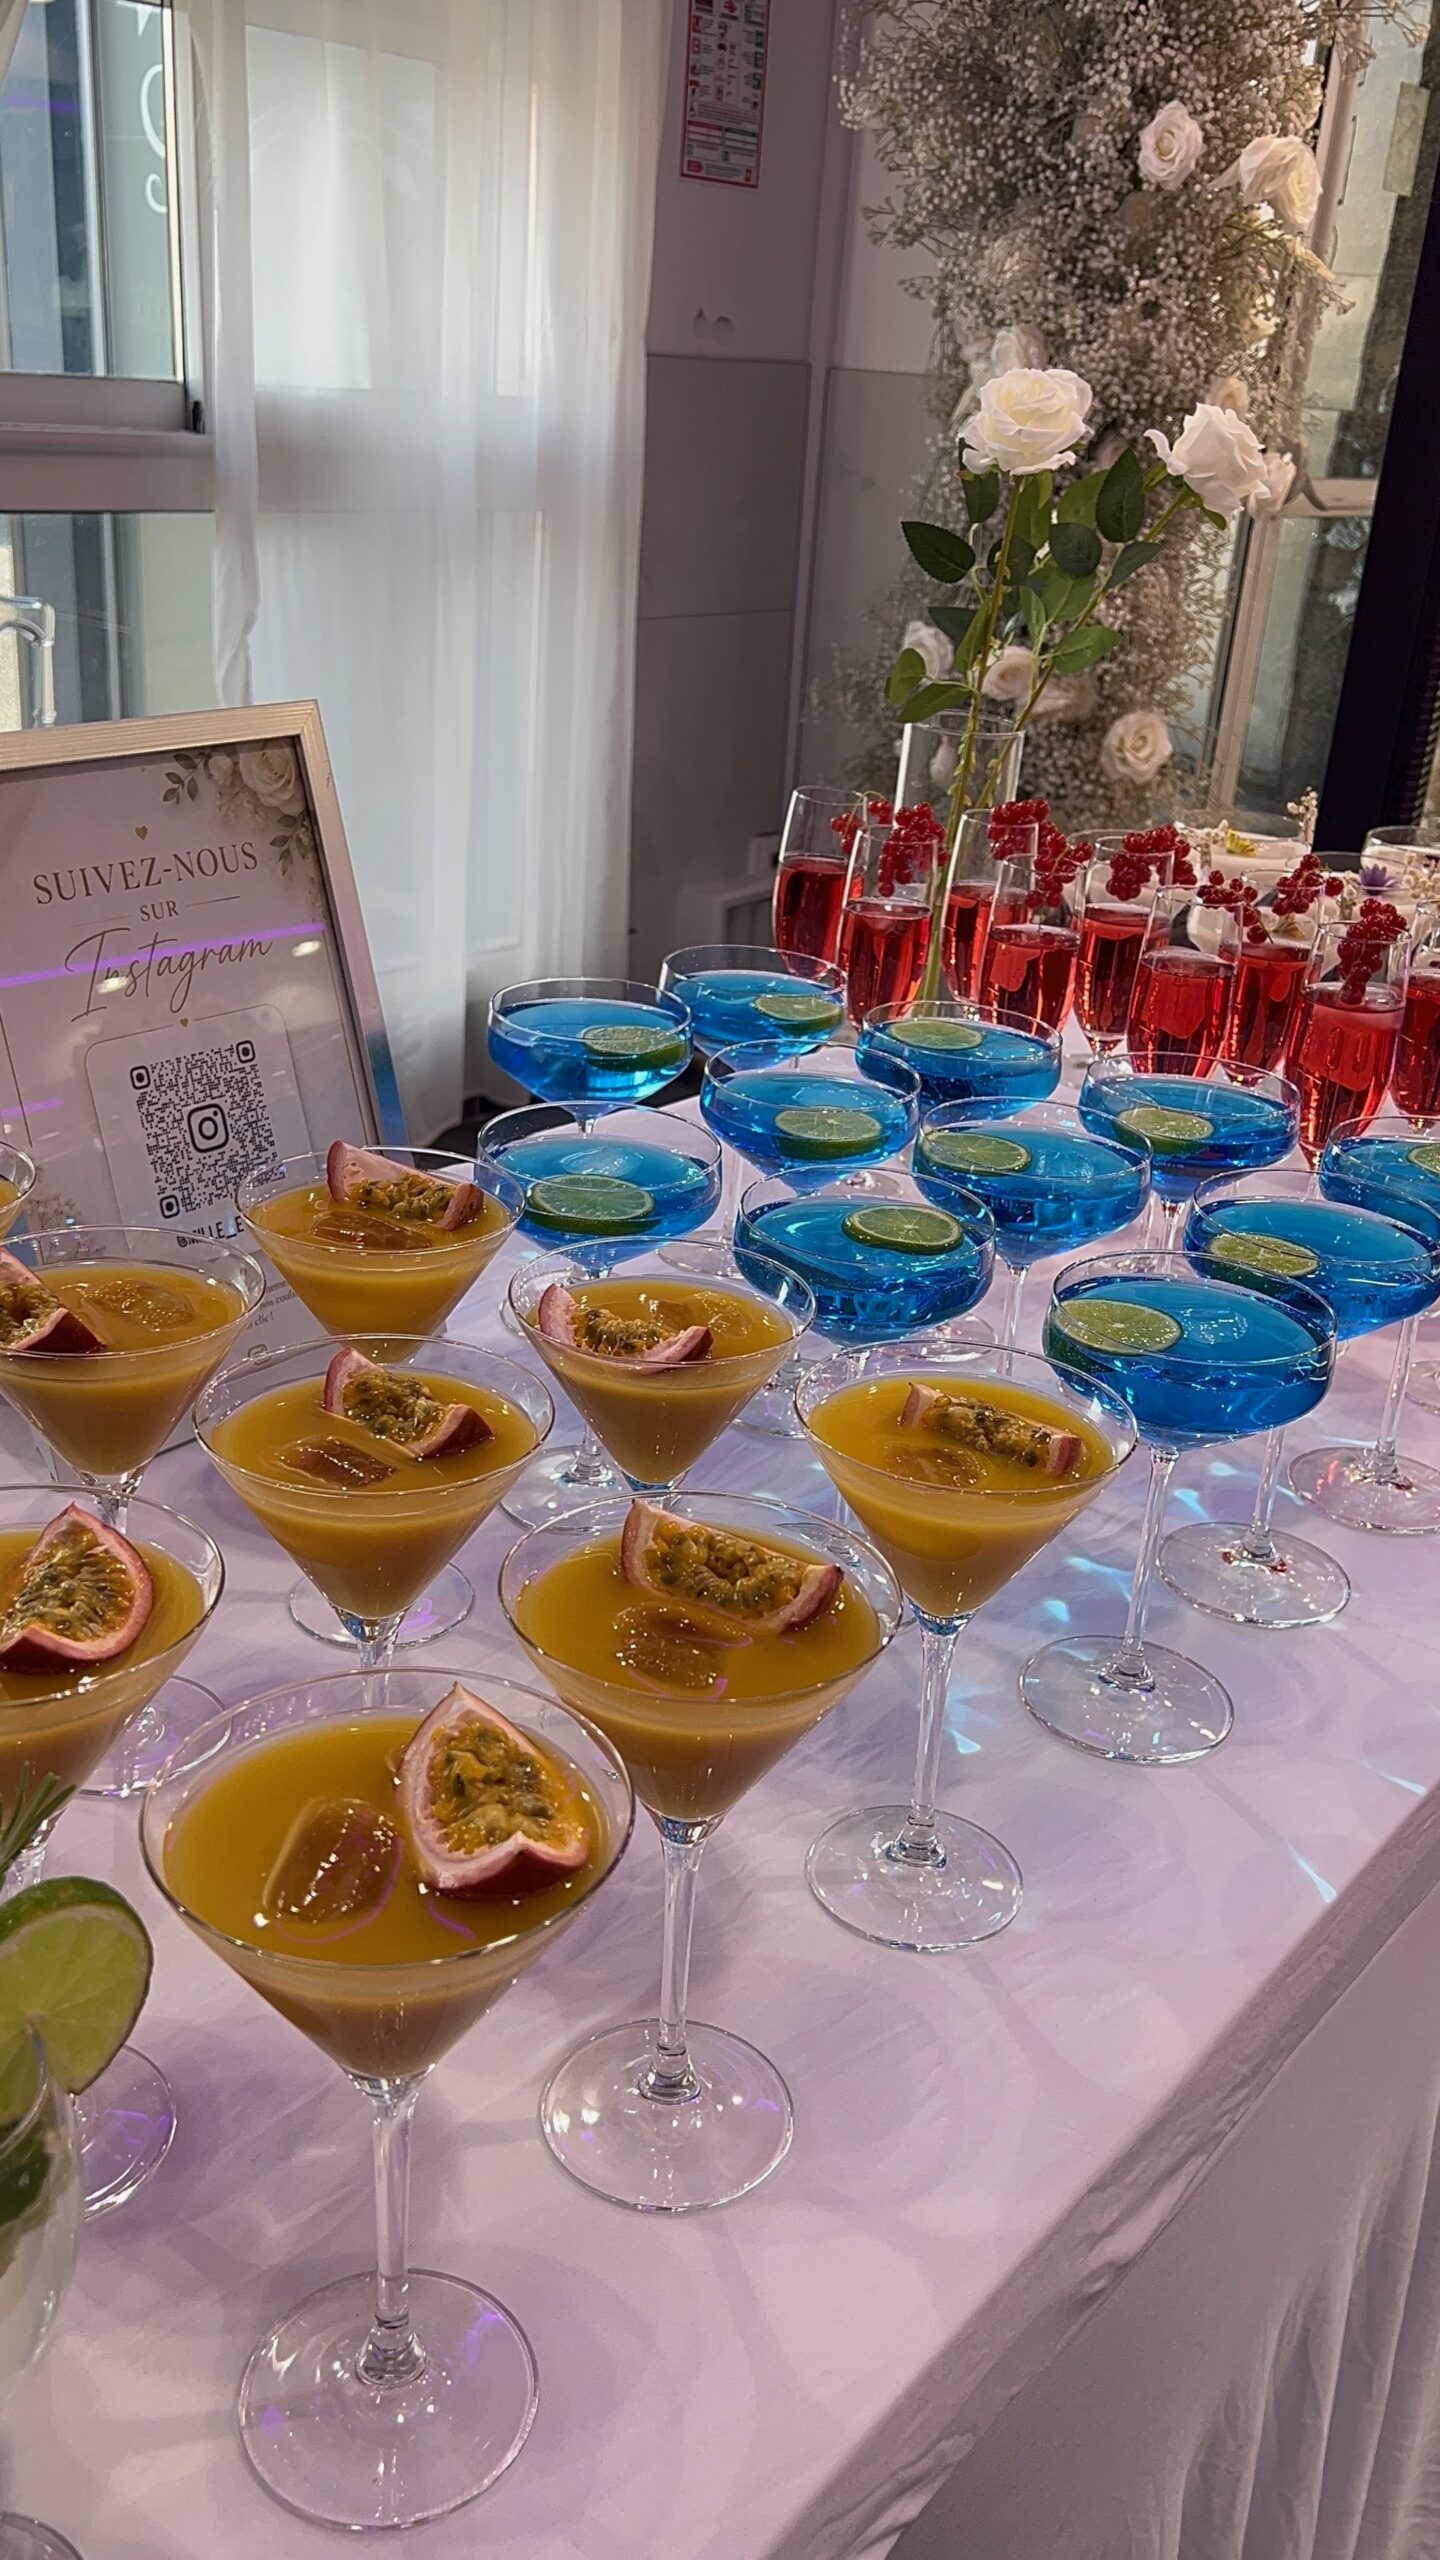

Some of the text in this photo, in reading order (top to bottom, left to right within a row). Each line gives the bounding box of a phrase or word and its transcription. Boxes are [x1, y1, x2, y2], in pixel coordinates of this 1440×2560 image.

[33, 841, 259, 905] SUIVEZ-NOUS
[139, 900, 180, 922] SUR
[64, 927, 273, 1023] Instagram
